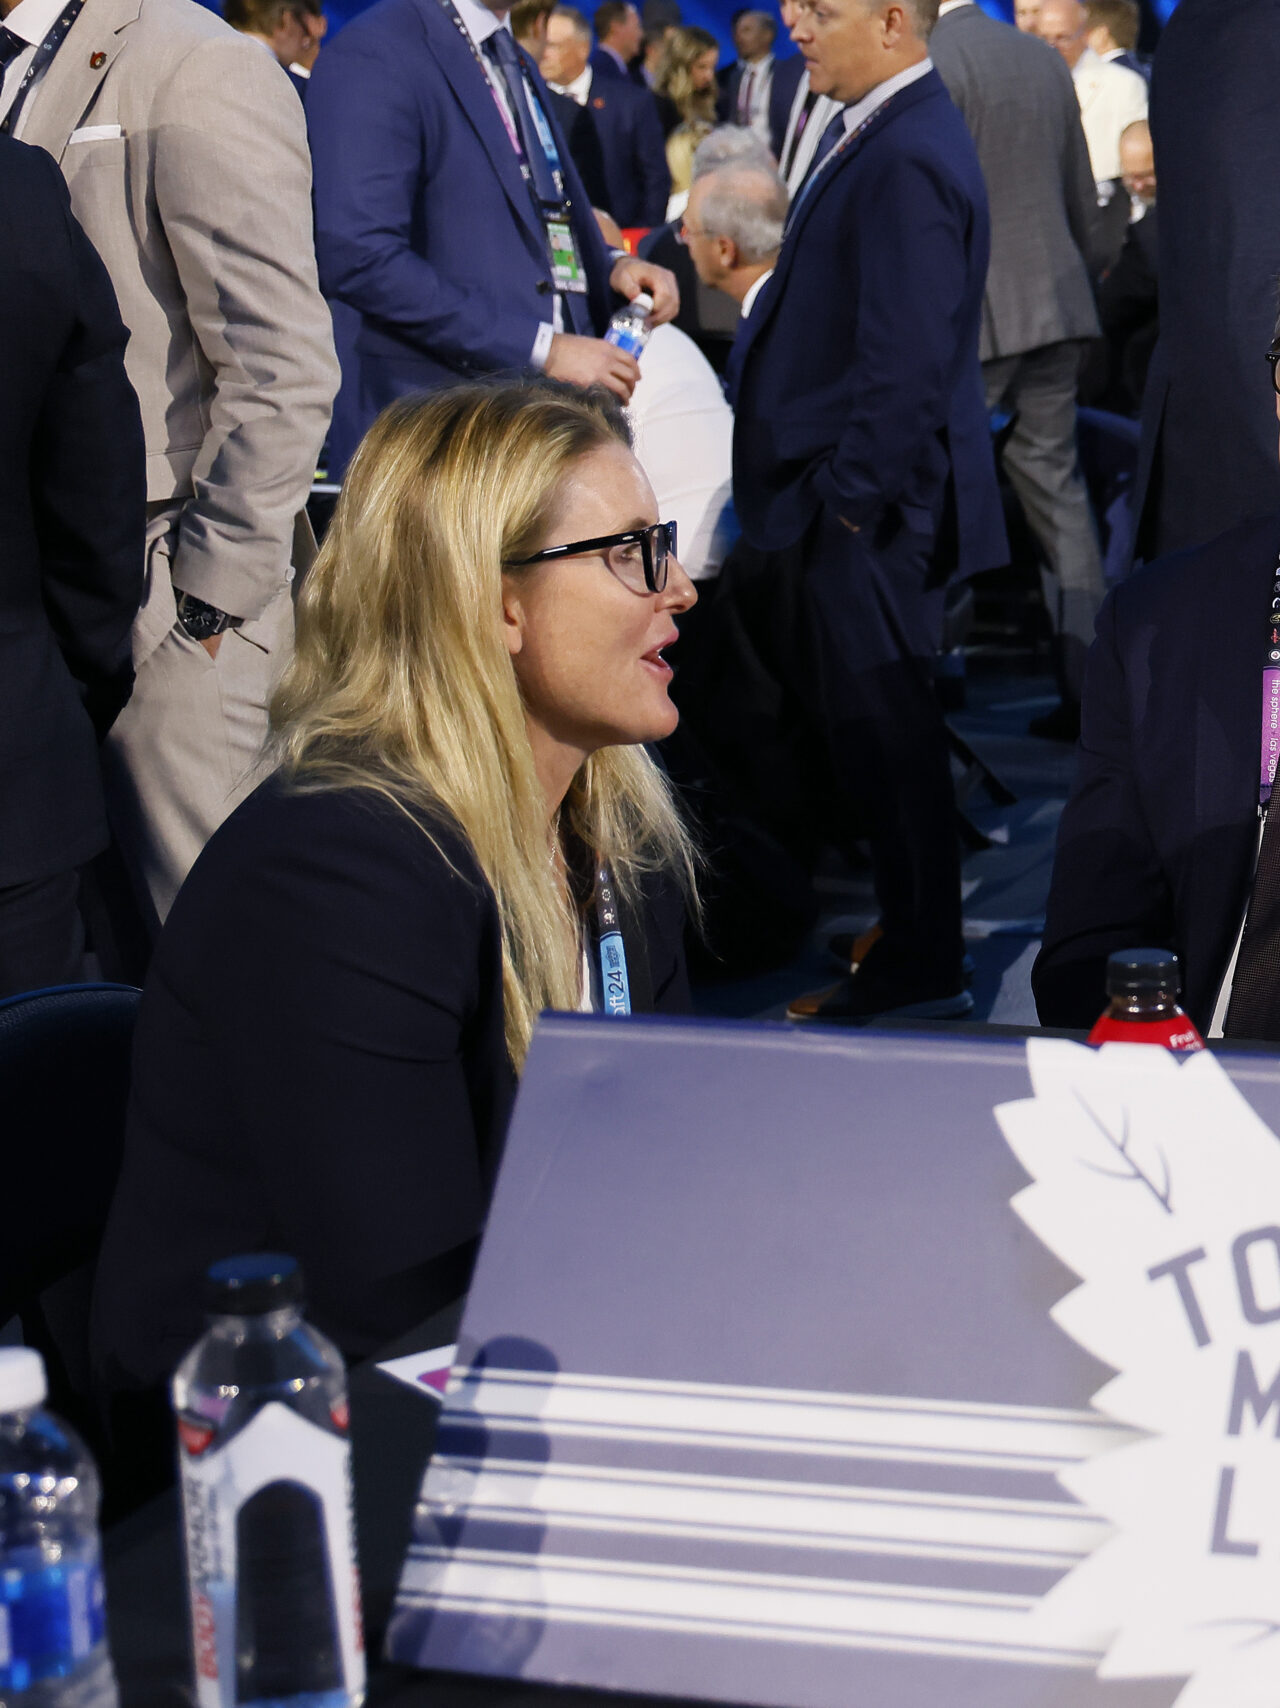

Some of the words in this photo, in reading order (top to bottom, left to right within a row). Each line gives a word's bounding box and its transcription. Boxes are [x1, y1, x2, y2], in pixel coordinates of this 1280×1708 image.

[1272, 679, 1280, 694] the
[1270, 697, 1279, 729] sphere
[1269, 738, 1278, 751] las
[1267, 754, 1276, 783] vegas
